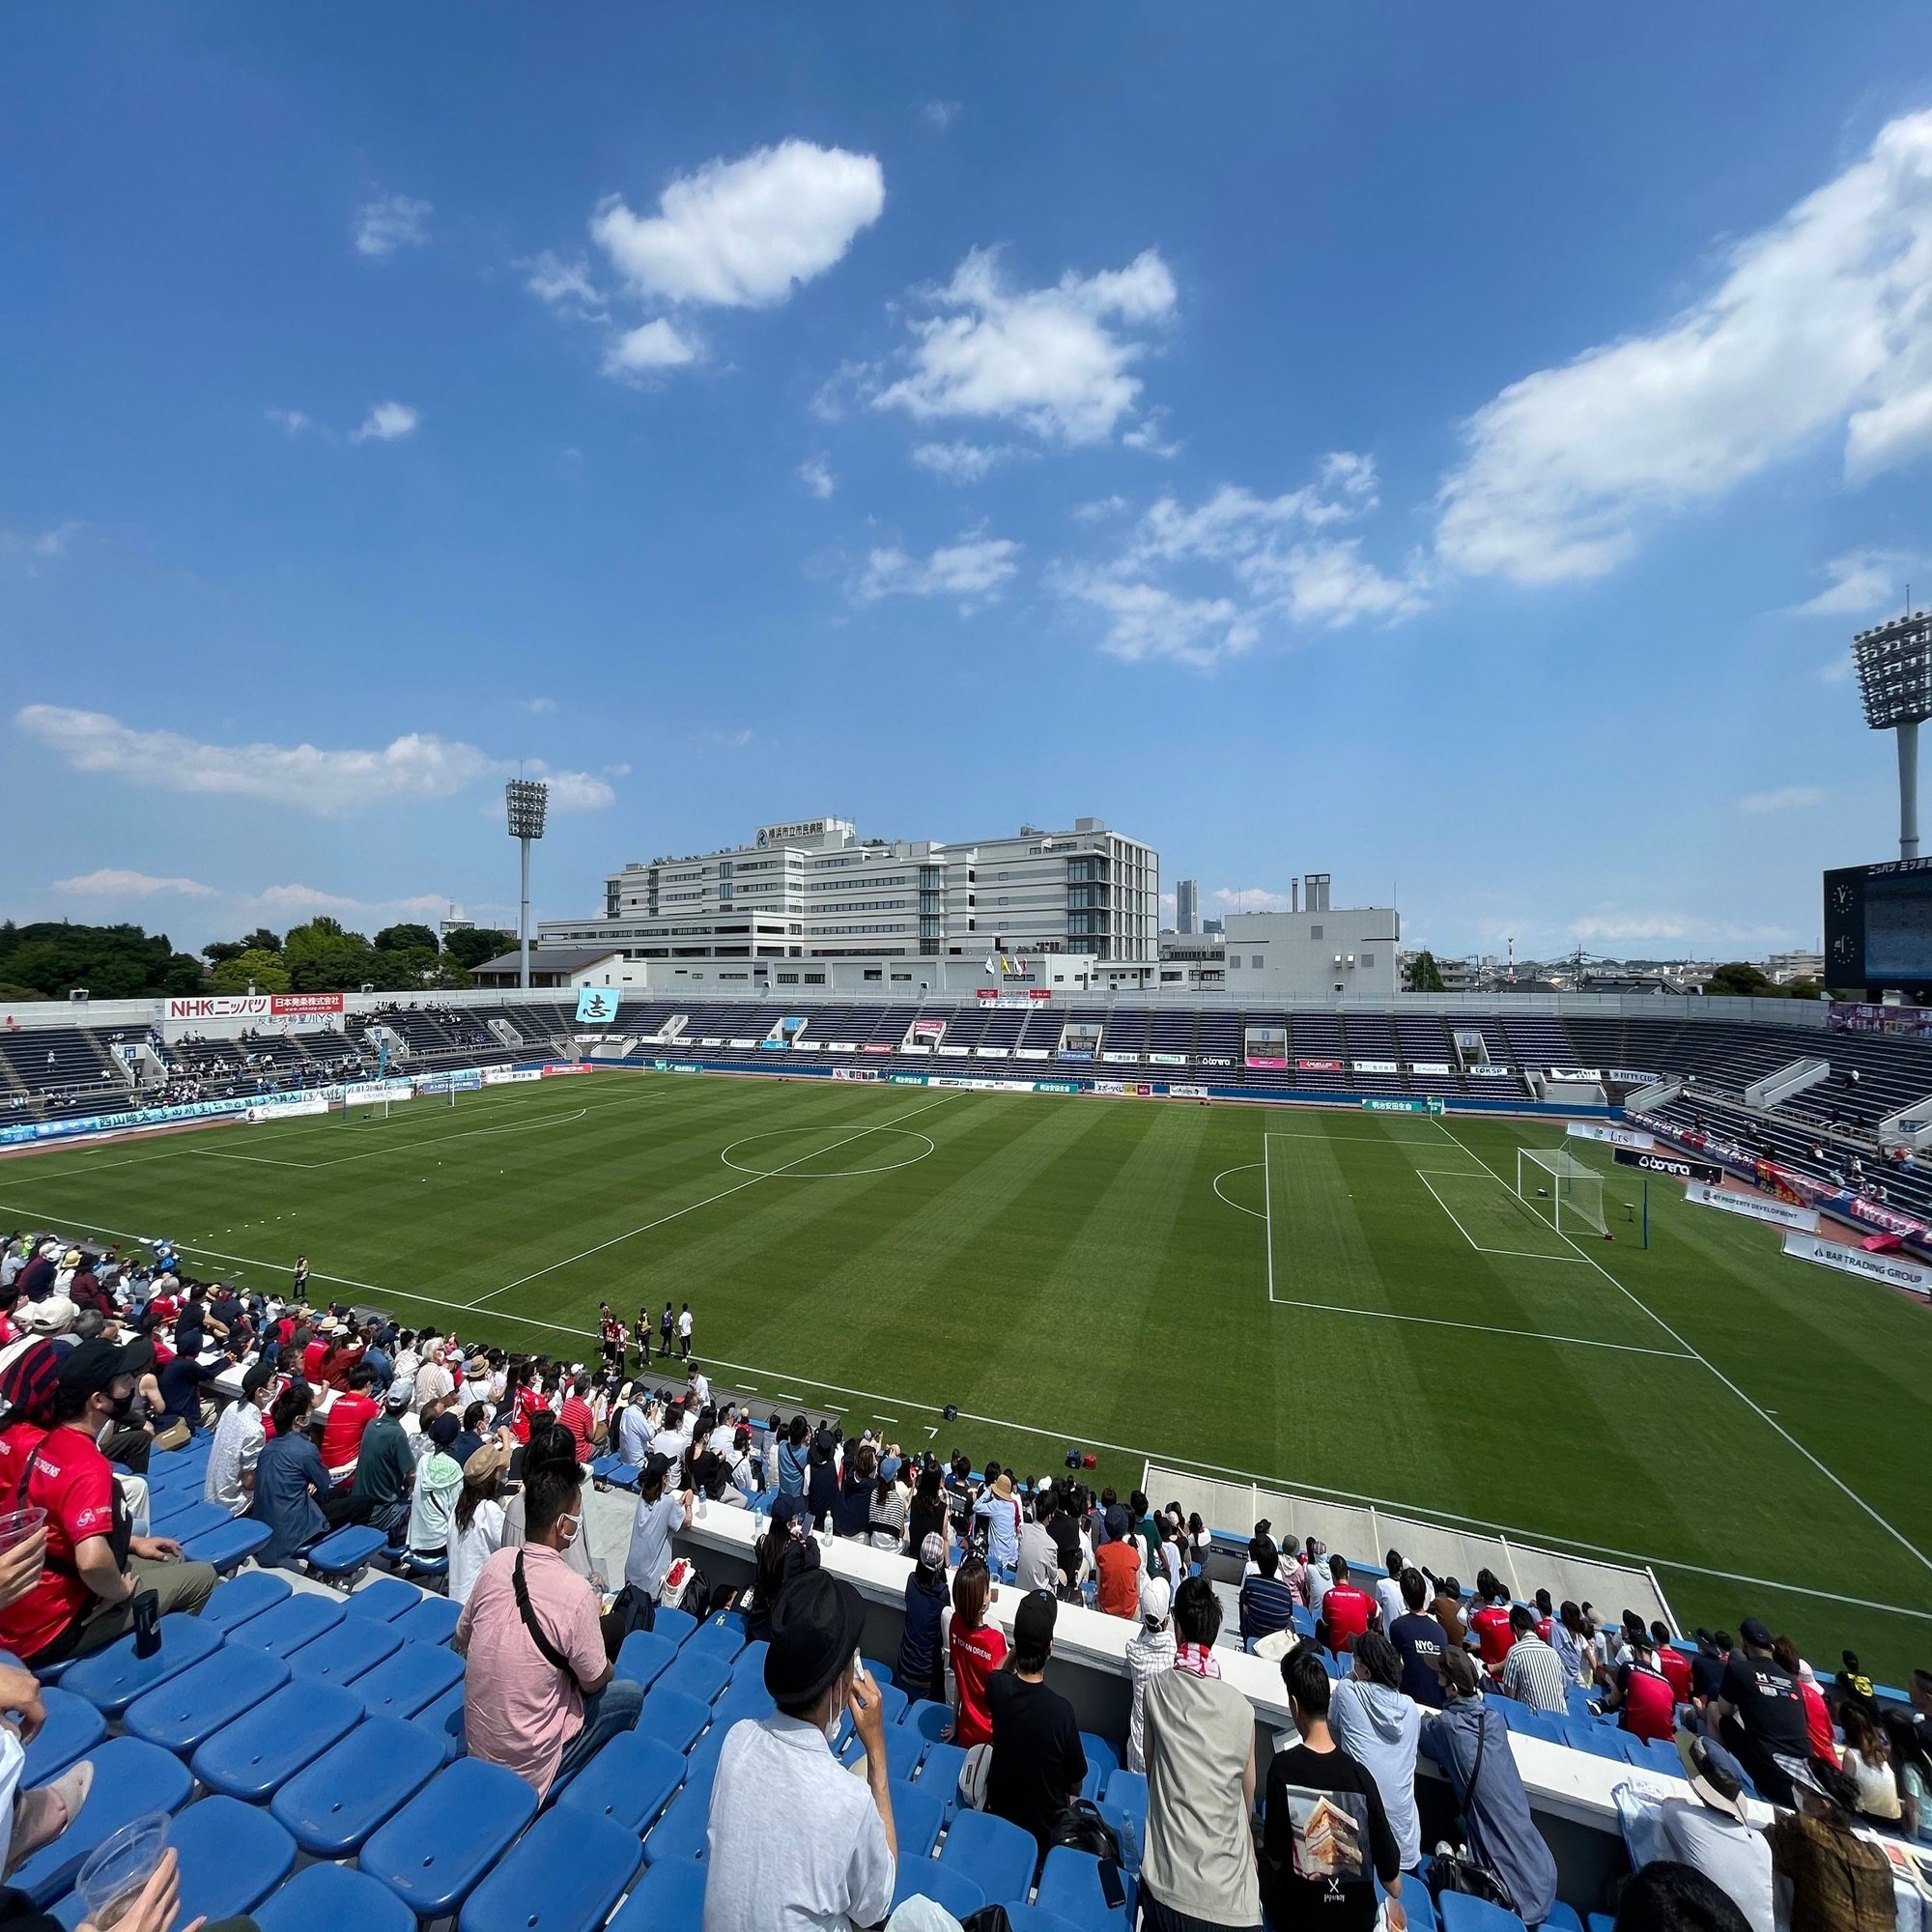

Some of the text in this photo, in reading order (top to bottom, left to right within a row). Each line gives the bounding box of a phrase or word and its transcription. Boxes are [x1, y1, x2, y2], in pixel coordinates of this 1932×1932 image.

[769, 822, 823, 838] 横浜市立市民病院
[171, 999, 267, 1016] NHK ニッパツ
[275, 996, 339, 1008] 日本発条株式会社
[582, 994, 611, 1017] 志
[1039, 1083, 1069, 1093] 明治安田生命
[1097, 1083, 1123, 1093] スポーツくじ
[1372, 1101, 1411, 1111] 明治安田生命
[99, 1111, 152, 1128] 西山峻太
[1721, 1196, 1750, 1208] PROPERTY
[1751, 1203, 1798, 1218] DEVELOPMENT
[1826, 1250, 1921, 1283] BAR TRADING GROUP
[973, 1646, 992, 1661] ORIENS
